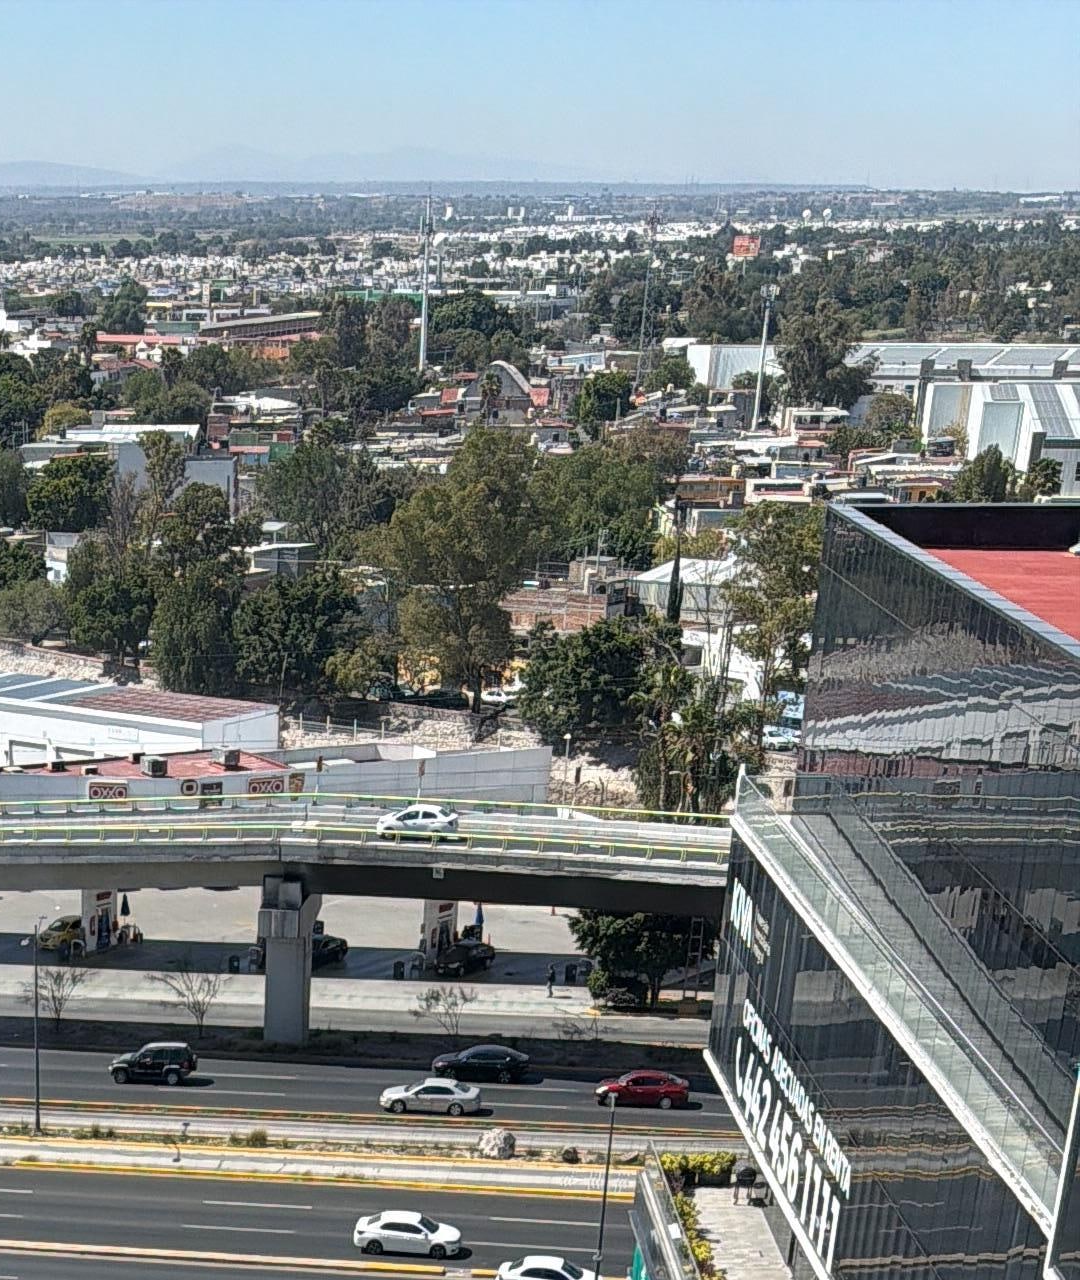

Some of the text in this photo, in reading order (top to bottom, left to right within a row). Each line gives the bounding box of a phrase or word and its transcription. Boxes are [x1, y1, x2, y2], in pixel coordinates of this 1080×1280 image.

[89, 785, 127, 800] OXXO
[249, 780, 285, 795] OXXO
[743, 999, 772, 1064] OFICINAS
[771, 1045, 815, 1134] ADECUADAS
[813, 1112, 827, 1155] EN
[820, 1130, 852, 1201] RENTA
[744, 1052, 772, 1152] 442
[771, 1099, 802, 1204] 456
